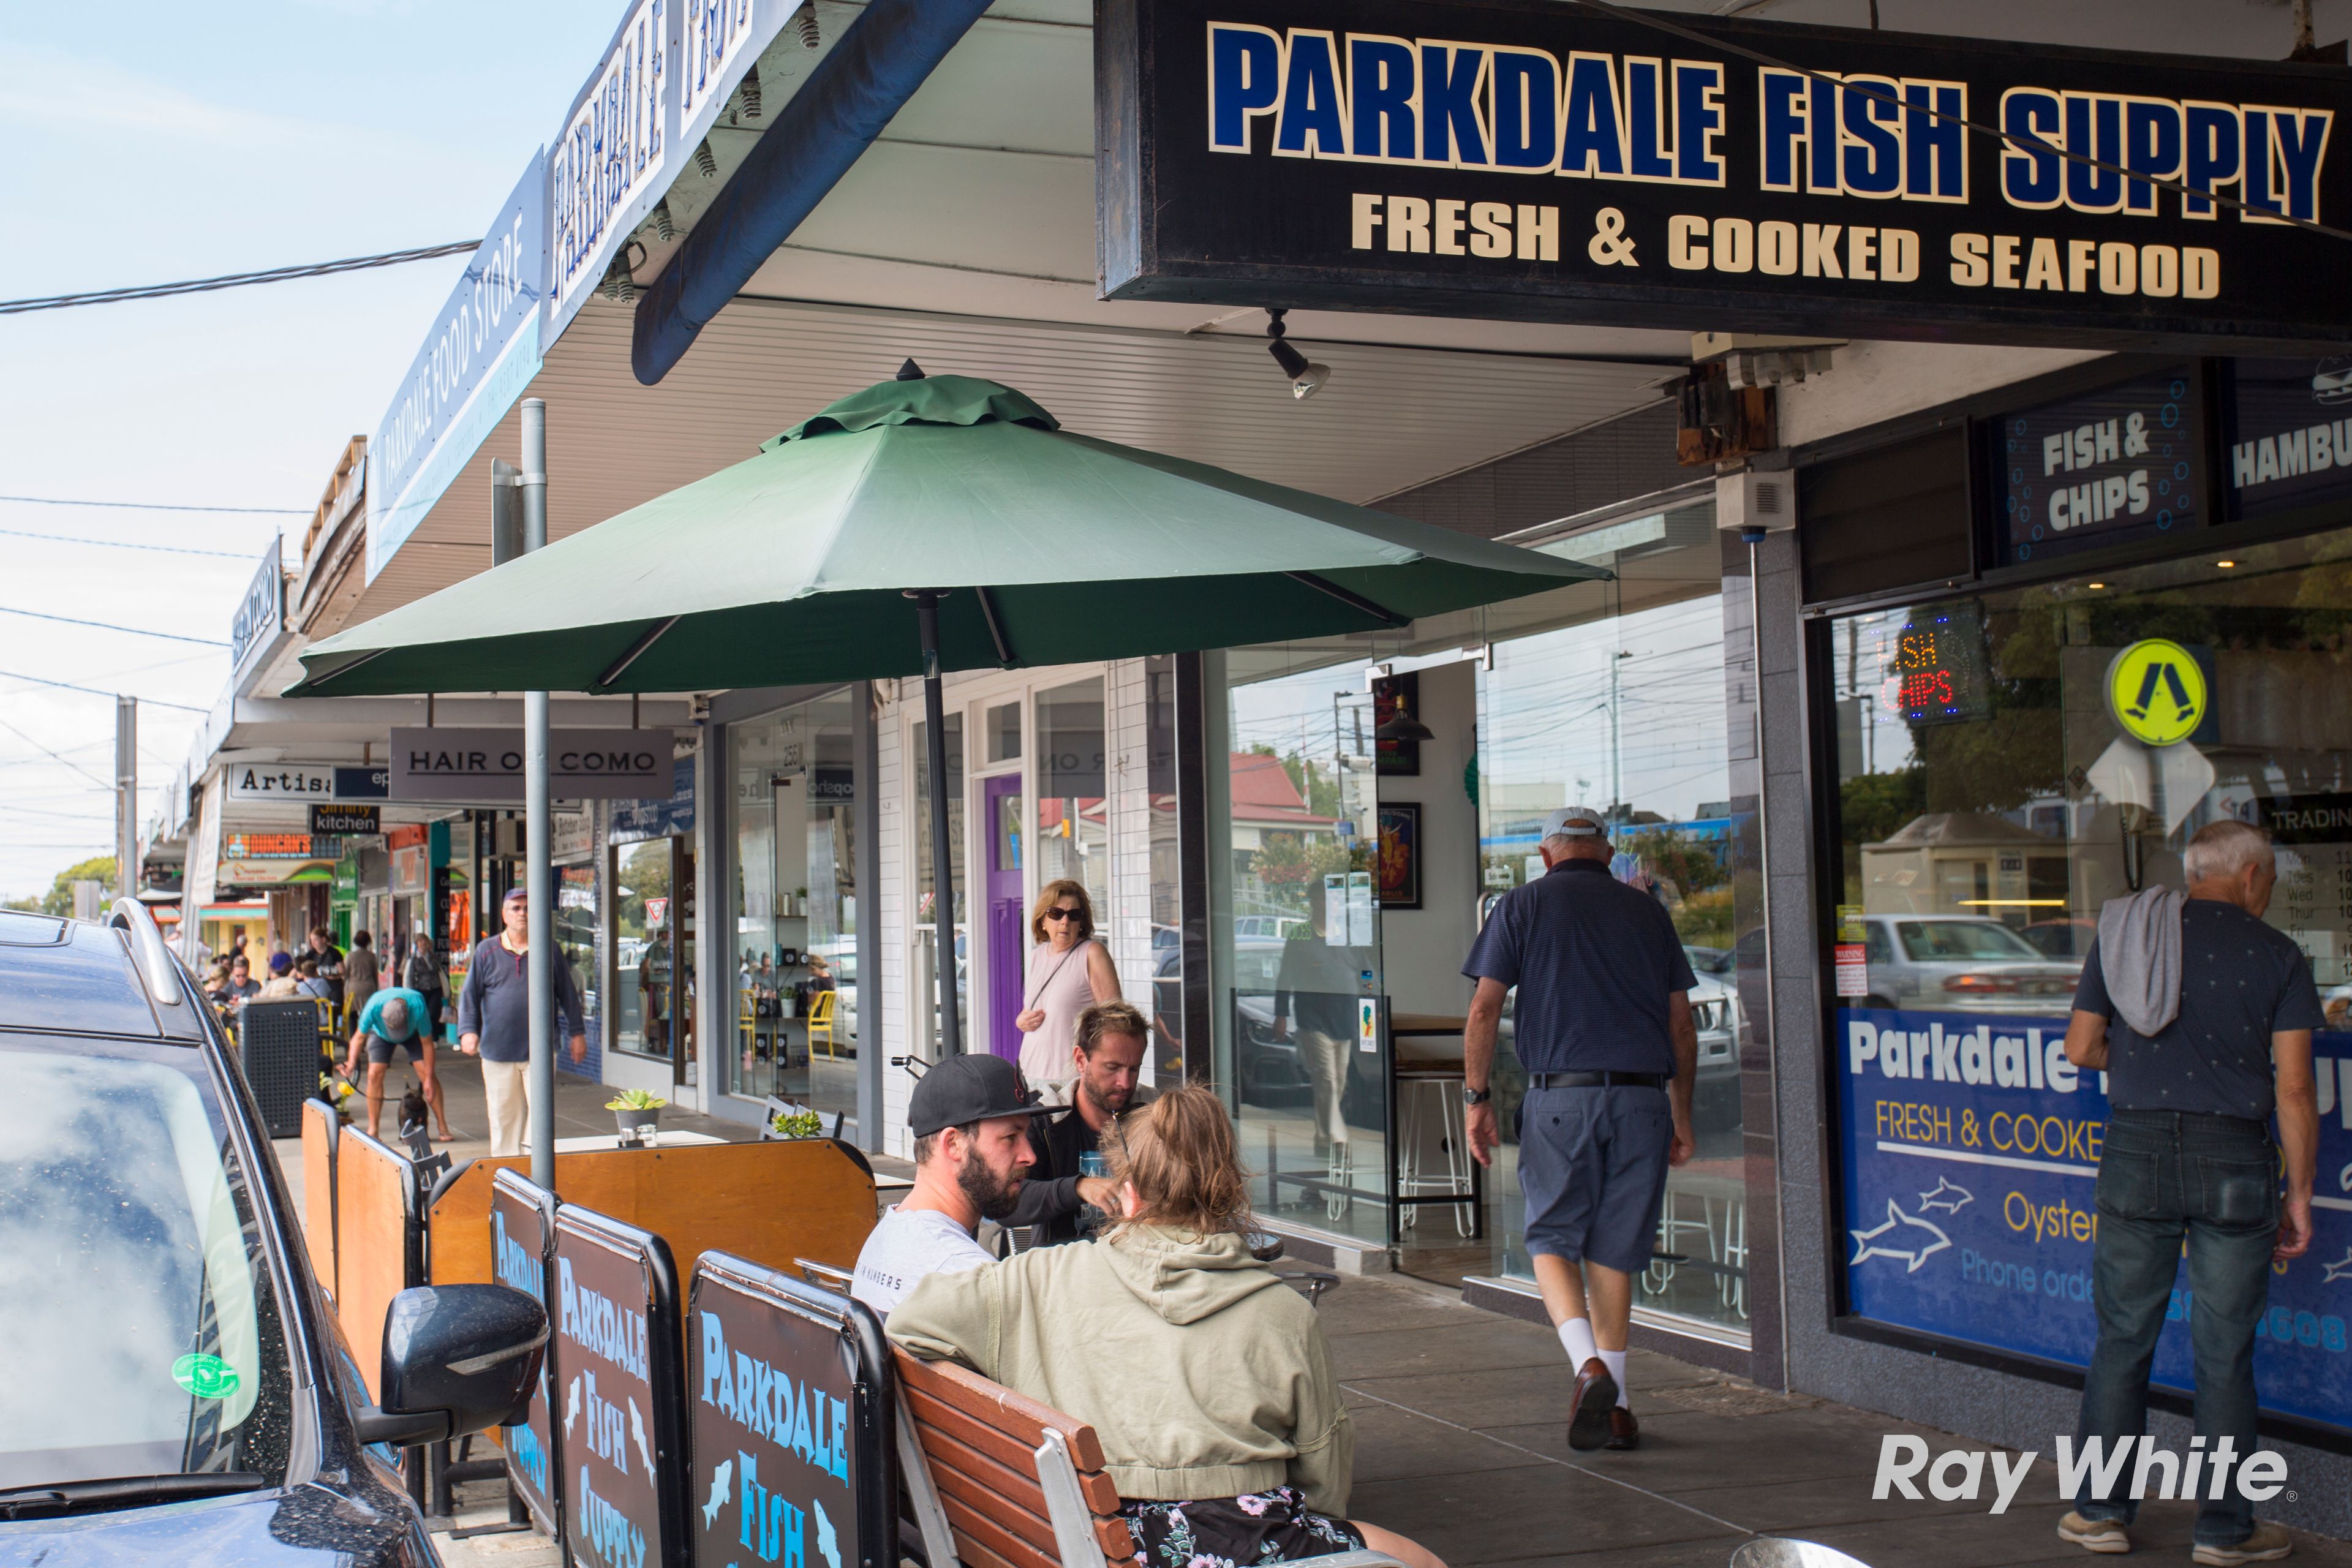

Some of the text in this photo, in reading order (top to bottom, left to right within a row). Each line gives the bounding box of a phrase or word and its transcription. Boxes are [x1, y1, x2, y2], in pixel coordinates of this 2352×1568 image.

[1207, 21, 2335, 225] PARKDALE FISH SUPPLY
[1351, 192, 2220, 299] FRESH & COOKED SEAFOOD
[385, 364, 431, 489] PARKDALE
[432, 315, 469, 414] FOOD
[474, 213, 523, 353] STORE
[2043, 412, 2149, 476] FISH &
[2233, 418, 2352, 488] HAMBU
[2049, 470, 2149, 532] CHIPS
[1876, 632, 1937, 673] FISH
[1881, 669, 1953, 710] CHIPS
[409, 751, 655, 771] HAIR O COMO
[317, 815, 375, 830] kitchen
[2272, 808, 2352, 829] TRADIN
[2286, 853, 2310, 865] Mon
[2286, 871, 2313, 884] Tues
[2288, 888, 2313, 902] Wed
[2288, 906, 2314, 919] Thur
[2290, 924, 2304, 937] Fri
[1849, 1021, 2078, 1093] Parkdale
[1876, 1101, 2103, 1162] FRESH & COOKE
[1962, 1248, 2094, 1303] Phone orde
[558, 1256, 649, 1388] PARKDALE
[584, 1369, 628, 1475] FISH
[700, 1310, 850, 1488] PARKDALE
[579, 1463, 647, 1568] SUPPLY
[738, 1449, 805, 1568] FISH
